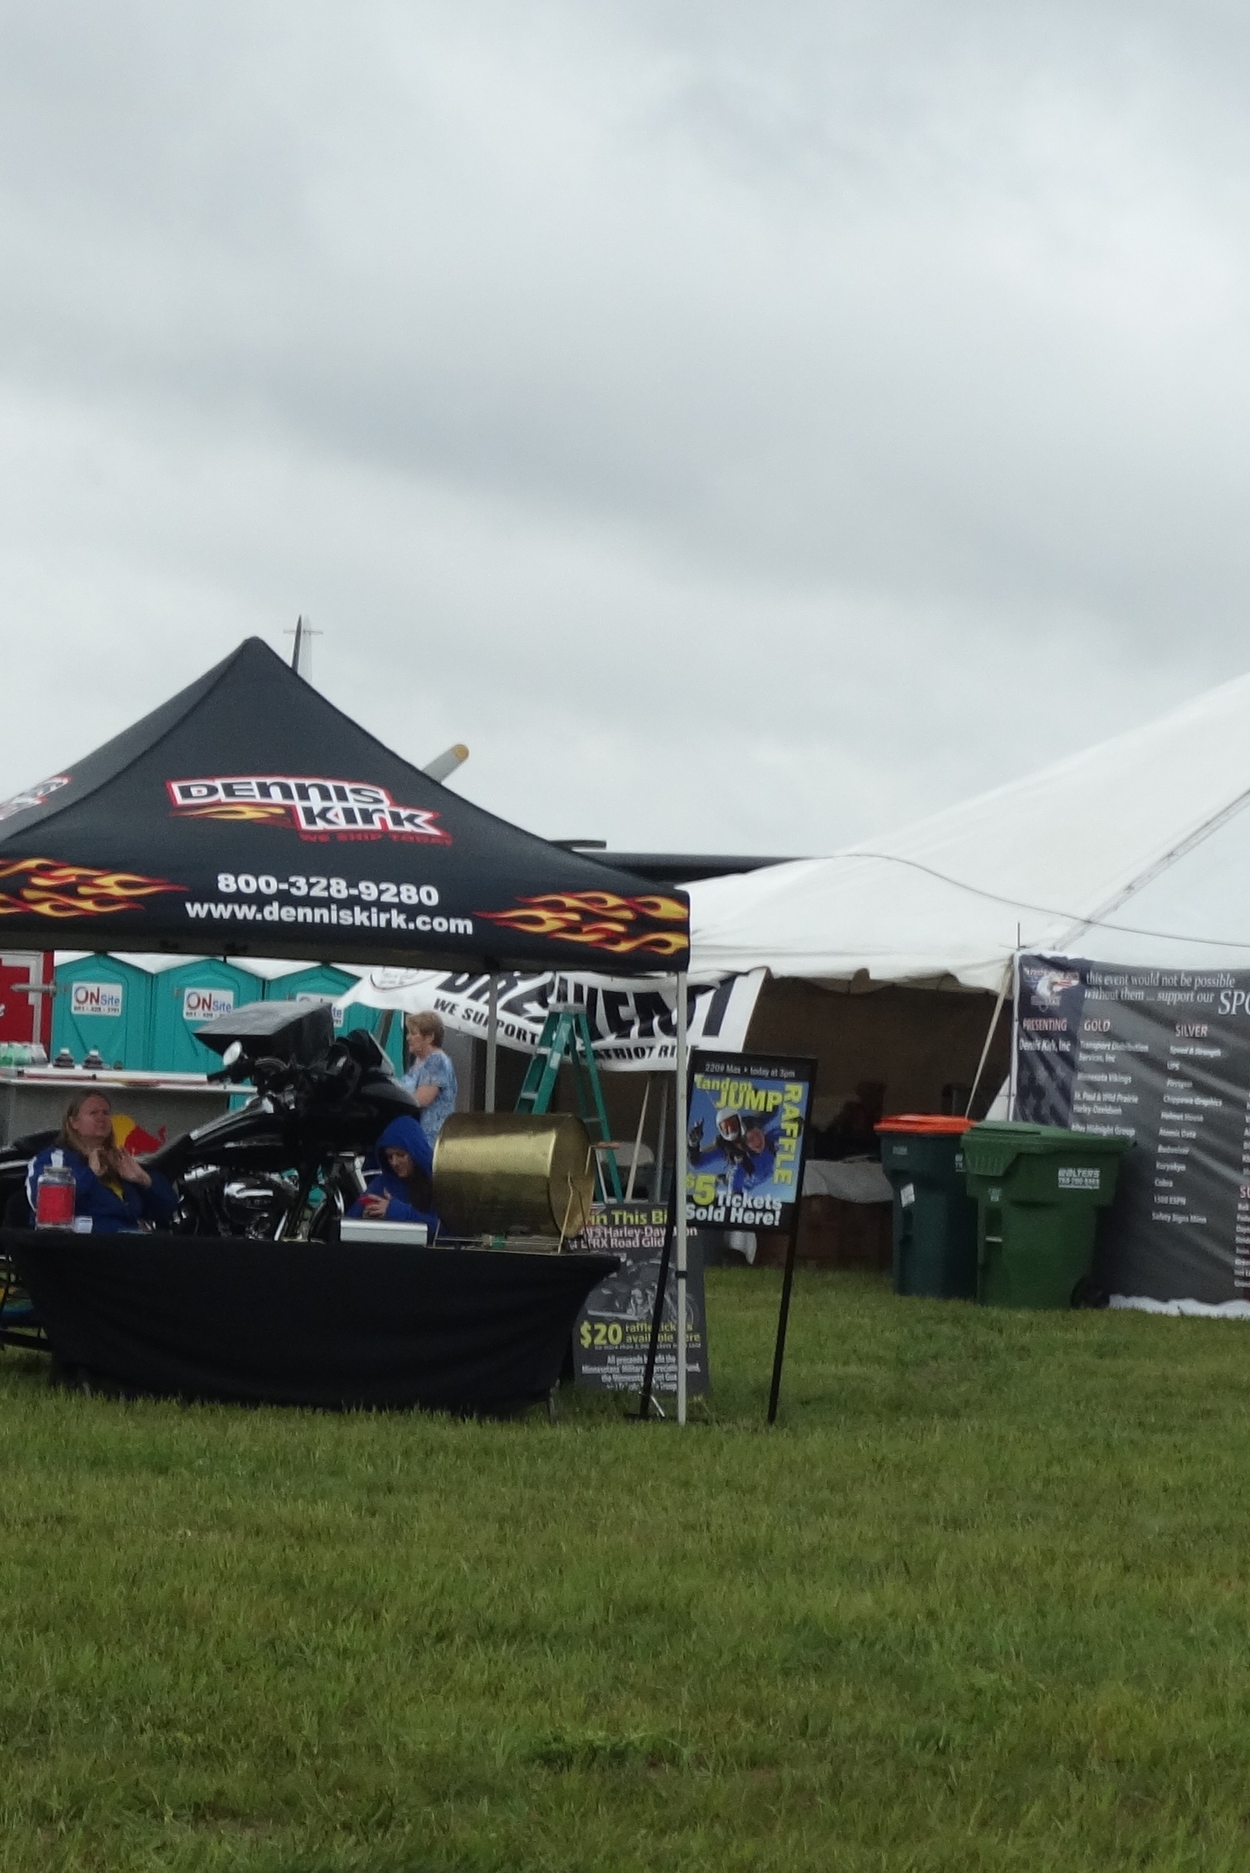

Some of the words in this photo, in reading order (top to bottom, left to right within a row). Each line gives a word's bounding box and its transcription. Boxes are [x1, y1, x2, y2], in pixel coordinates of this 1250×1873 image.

[217, 873, 439, 906] 800-328-9280
[186, 901, 474, 935] www.denniskirk.com
[1086, 970, 1102, 985] this
[1104, 973, 1129, 986] event
[1131, 971, 1160, 987] would
[1161, 973, 1178, 987] not
[1180, 972, 1192, 987] be
[1194, 973, 1236, 990] possible
[1084, 987, 1119, 1001] without
[1120, 987, 1145, 1001] them
[1157, 991, 1194, 1006] support
[1197, 992, 1215, 1003] our
[433, 998, 459, 1016] WE
[1022, 1017, 1067, 1032] PRESENTING
[1083, 1018, 1111, 1033] GOLD
[1175, 1023, 1209, 1038] SILVER
[750, 1066, 769, 1078] today
[779, 1068, 796, 1079] 3pm
[715, 1086, 784, 1113] JUMP
[773, 1083, 804, 1186] RAFFLE
[716, 1187, 783, 1211] Tickets
[610, 1208, 648, 1226] This
[686, 1201, 726, 1222] Sold
[730, 1206, 782, 1227] Here!
[610, 1237, 641, 1249] Road
[641, 1236, 665, 1248] Glid
[580, 1320, 623, 1349] $20
[626, 1332, 674, 1343] availble
